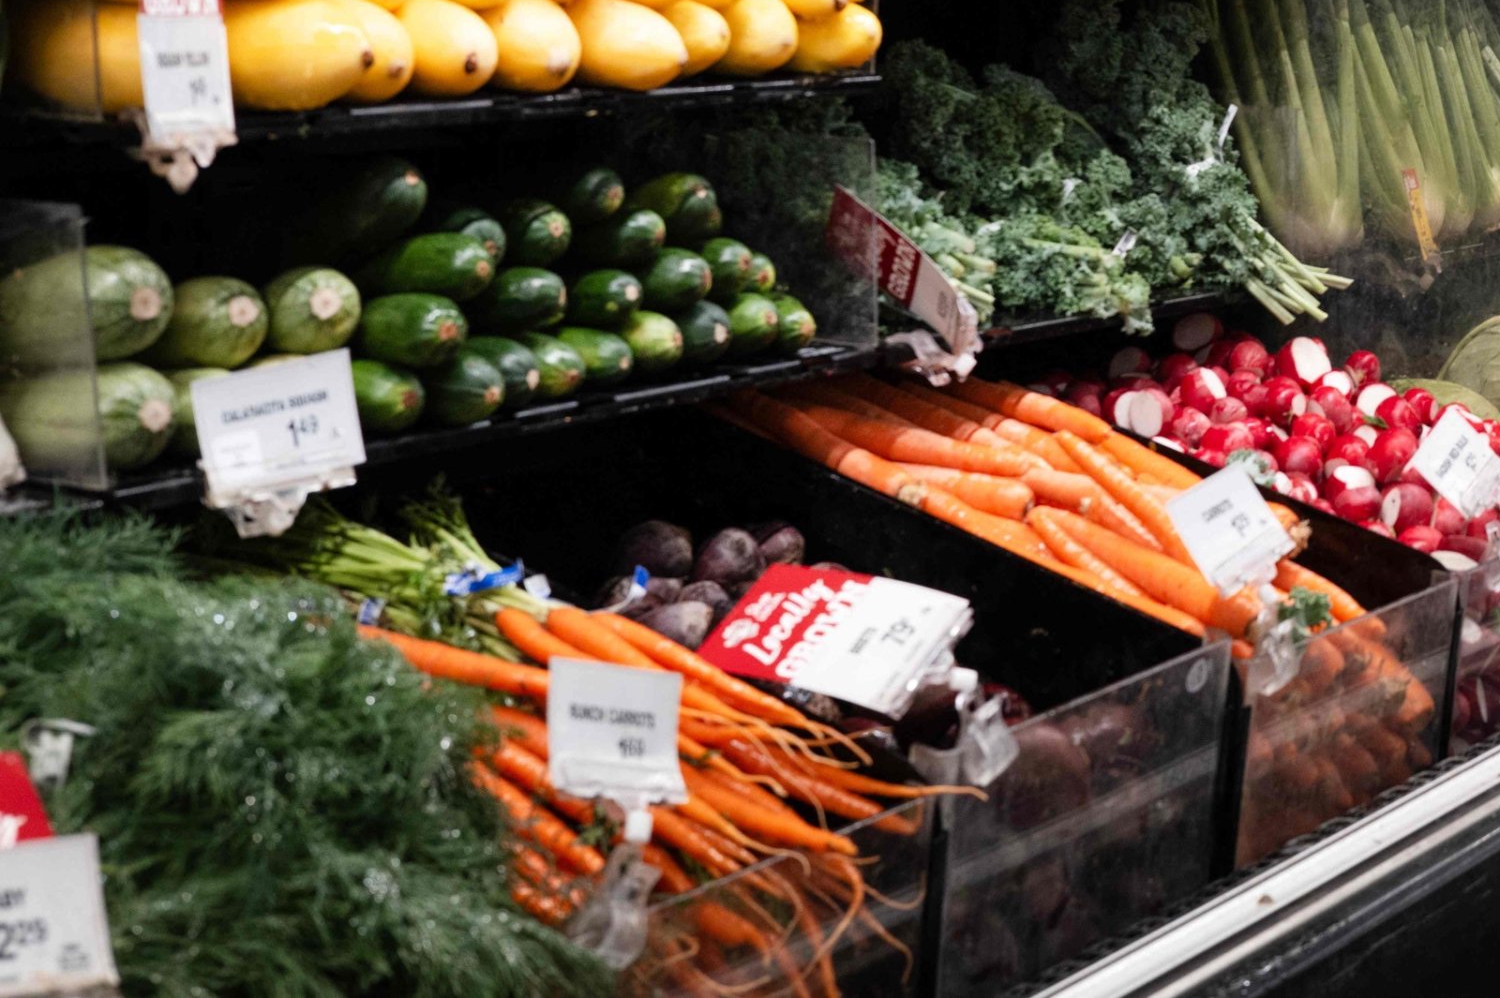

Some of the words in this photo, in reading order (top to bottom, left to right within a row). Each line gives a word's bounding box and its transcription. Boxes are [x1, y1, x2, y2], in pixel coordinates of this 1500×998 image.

[742, 578, 835, 667] Locally
[569, 702, 604, 721] BUNCH
[609, 708, 656, 729] CARROTS
